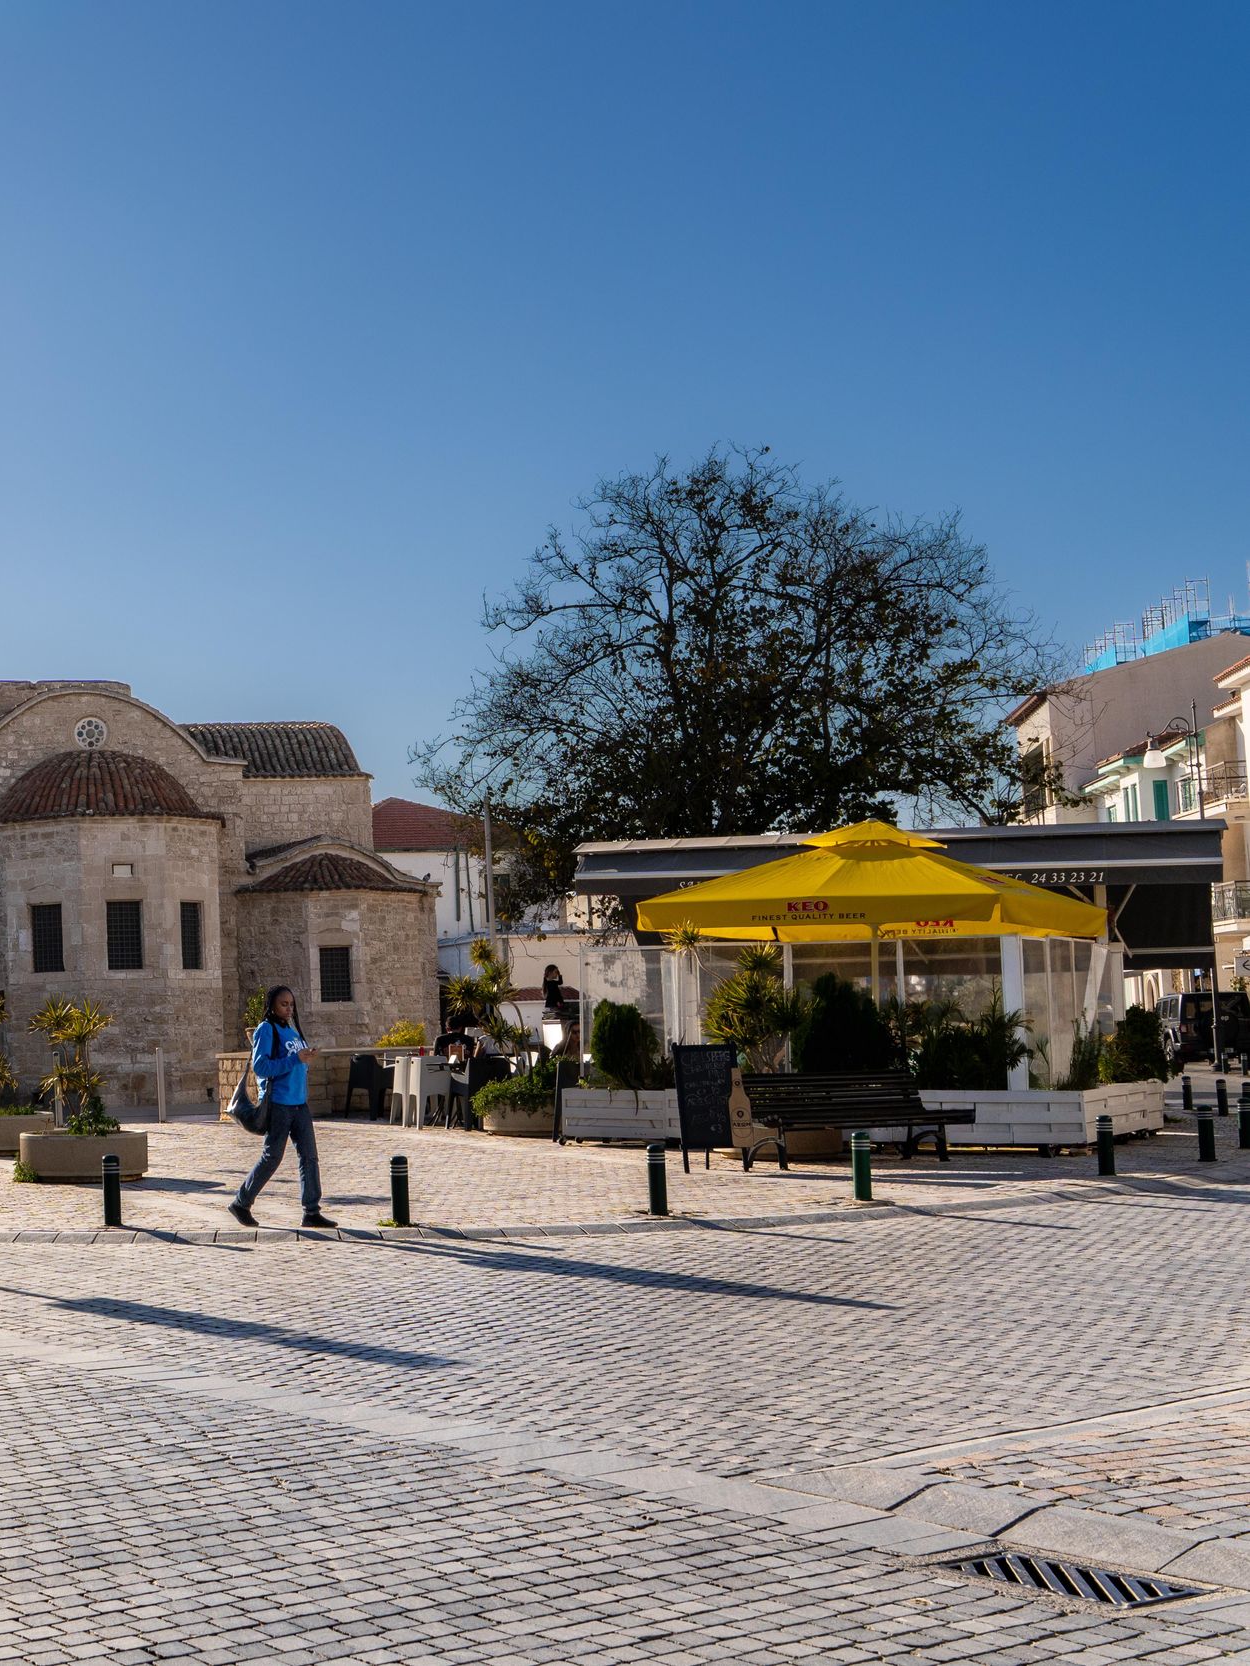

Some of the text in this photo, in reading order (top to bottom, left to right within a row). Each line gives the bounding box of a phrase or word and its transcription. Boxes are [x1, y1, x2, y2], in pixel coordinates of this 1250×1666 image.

[1031, 873, 1047, 883] 24
[1050, 873, 1066, 883] 33
[1070, 872, 1086, 882] 23
[1090, 872, 1105, 882] 21
[787, 900, 830, 912] KEO
[791, 912, 834, 921] QUALITY
